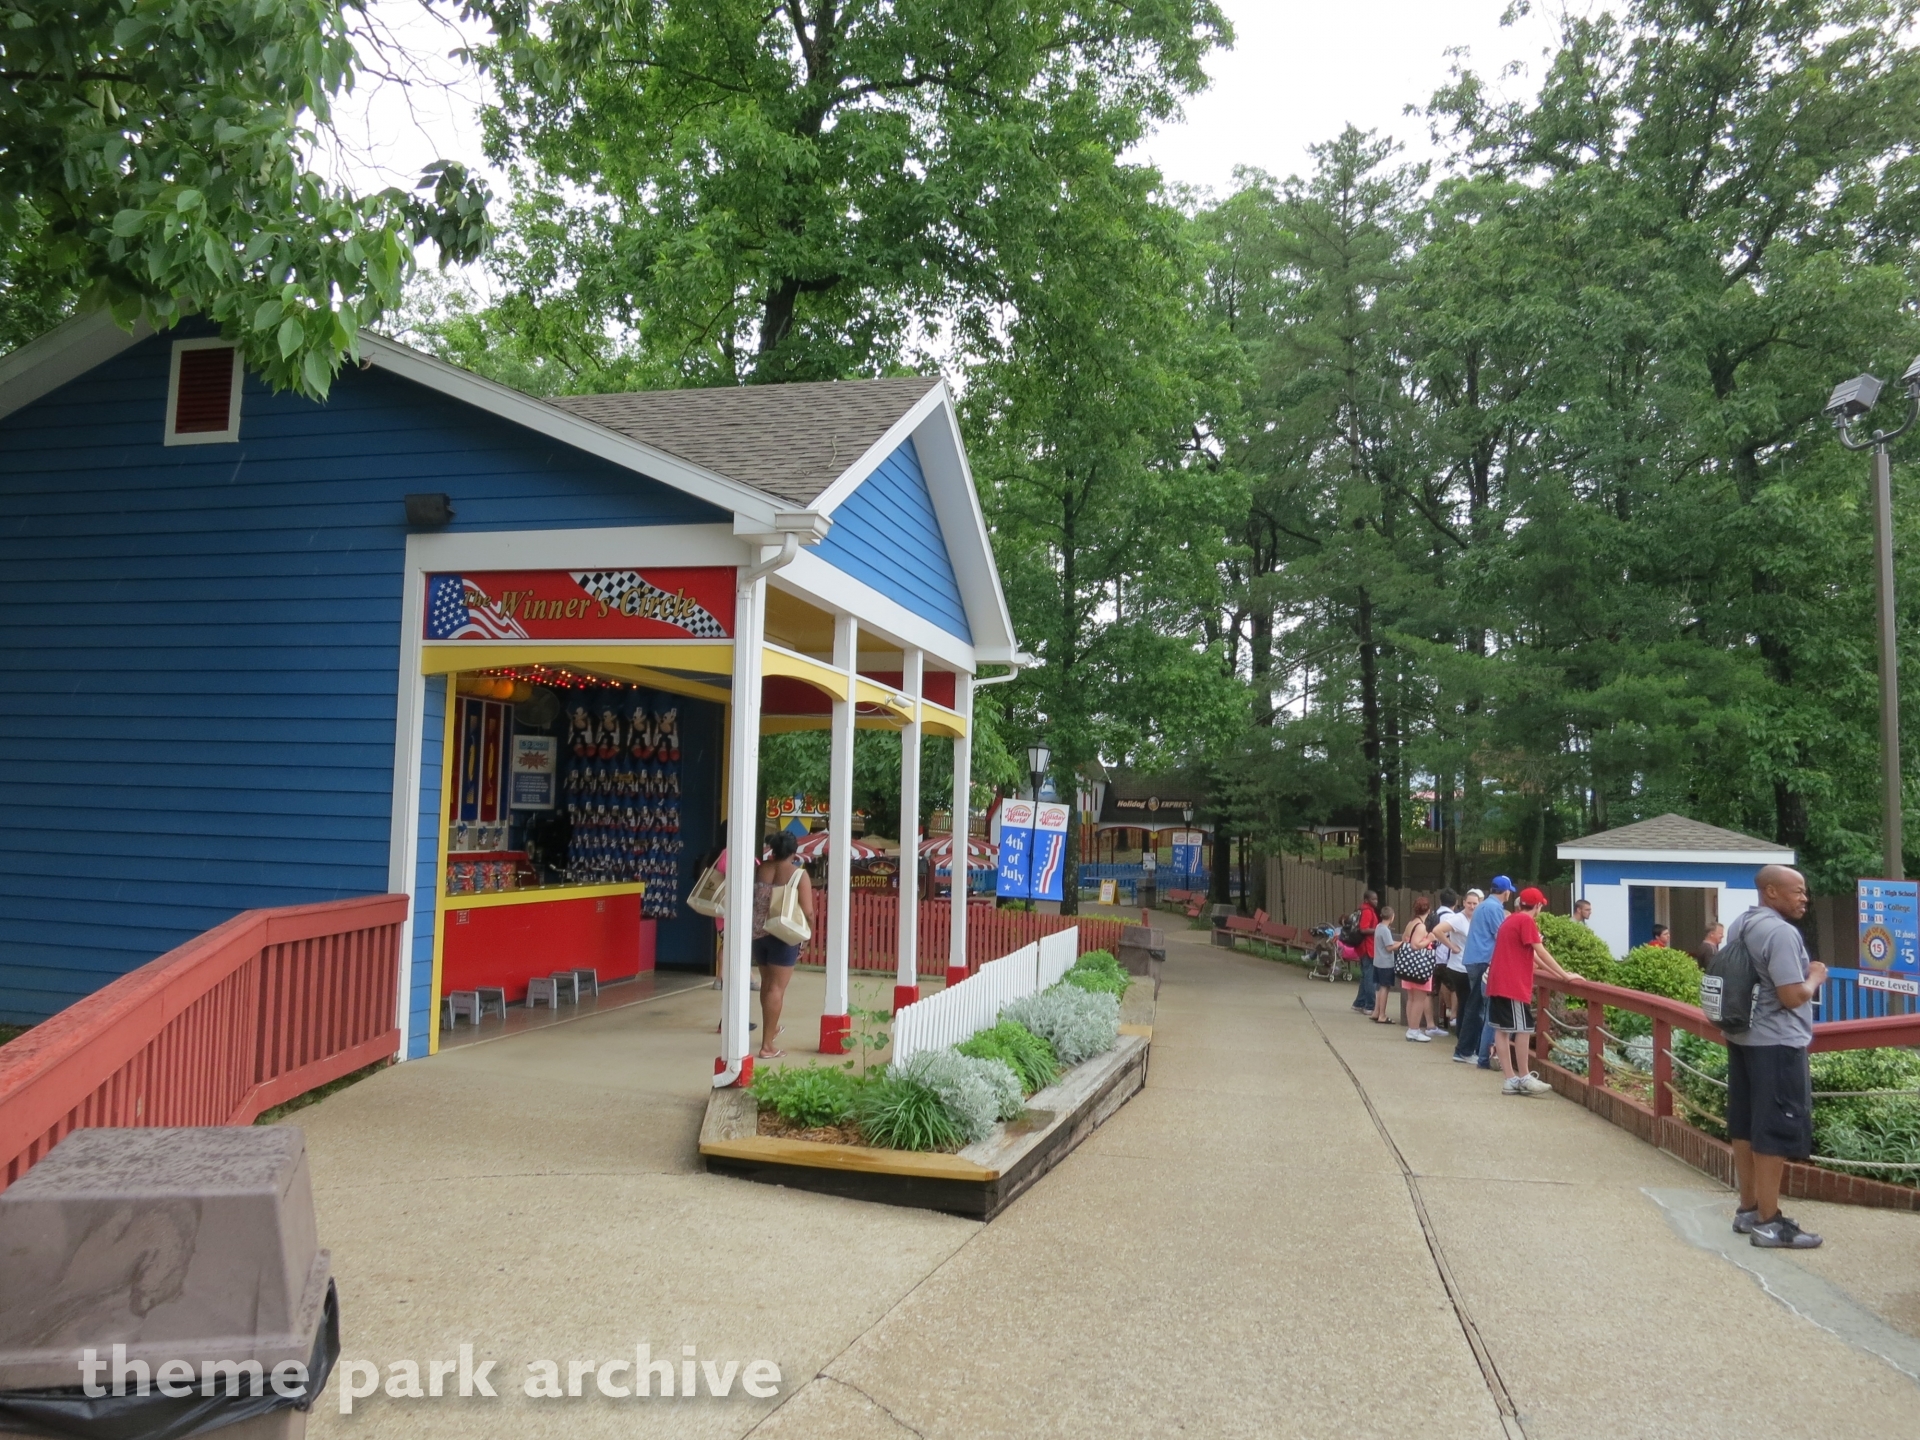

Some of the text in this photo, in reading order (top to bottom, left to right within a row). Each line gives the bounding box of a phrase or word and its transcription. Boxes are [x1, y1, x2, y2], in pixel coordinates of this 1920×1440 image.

[462, 586, 697, 621] The Winner's Circle
[1005, 807, 1032, 819] Holiday
[1039, 811, 1066, 822] Holiday
[1007, 815, 1026, 824] World
[1041, 818, 1060, 827] World
[1005, 834, 1023, 850] 4th
[1008, 853, 1019, 865] of
[1001, 865, 1024, 886] July
[1887, 903, 1910, 913] College
[1894, 929, 1916, 939] 12 shots
[1872, 943, 1882, 953] 15
[1901, 948, 1914, 964] $5
[1862, 976, 1915, 992] Prize Levels
